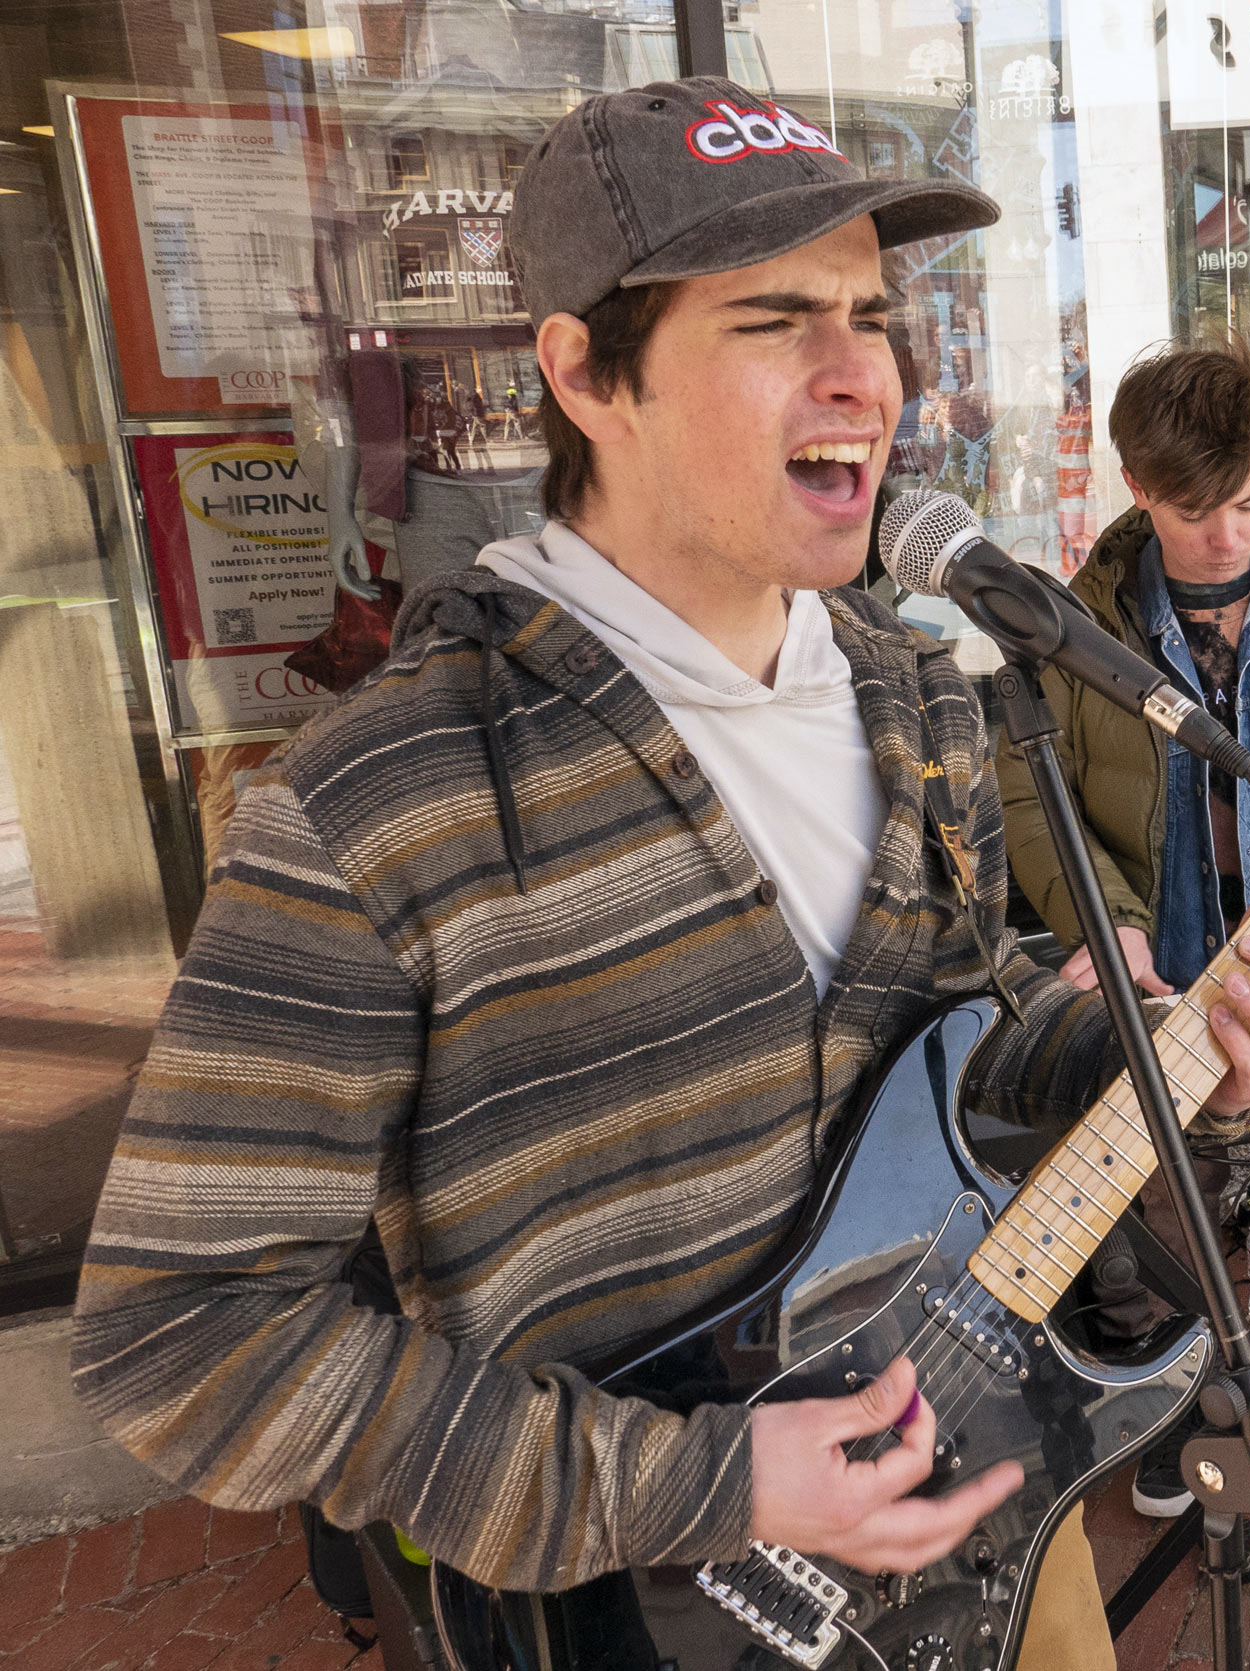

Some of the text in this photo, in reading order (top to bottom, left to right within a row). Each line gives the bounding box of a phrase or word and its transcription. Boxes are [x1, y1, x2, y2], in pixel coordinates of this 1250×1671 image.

[154, 133, 273, 145] BRATTLE STREET COOP
[459, 271, 514, 286] SCHOOL
[231, 370, 286, 389] COOP
[226, 526, 325, 538] FLEXIBLE HOURS!
[232, 541, 322, 553] ALL POSITIONS!
[211, 557, 276, 568] IMMEDIATE
[208, 573, 258, 584] SUMMER
[249, 586, 325, 602] Apply Now!
[235, 670, 249, 702] THE
